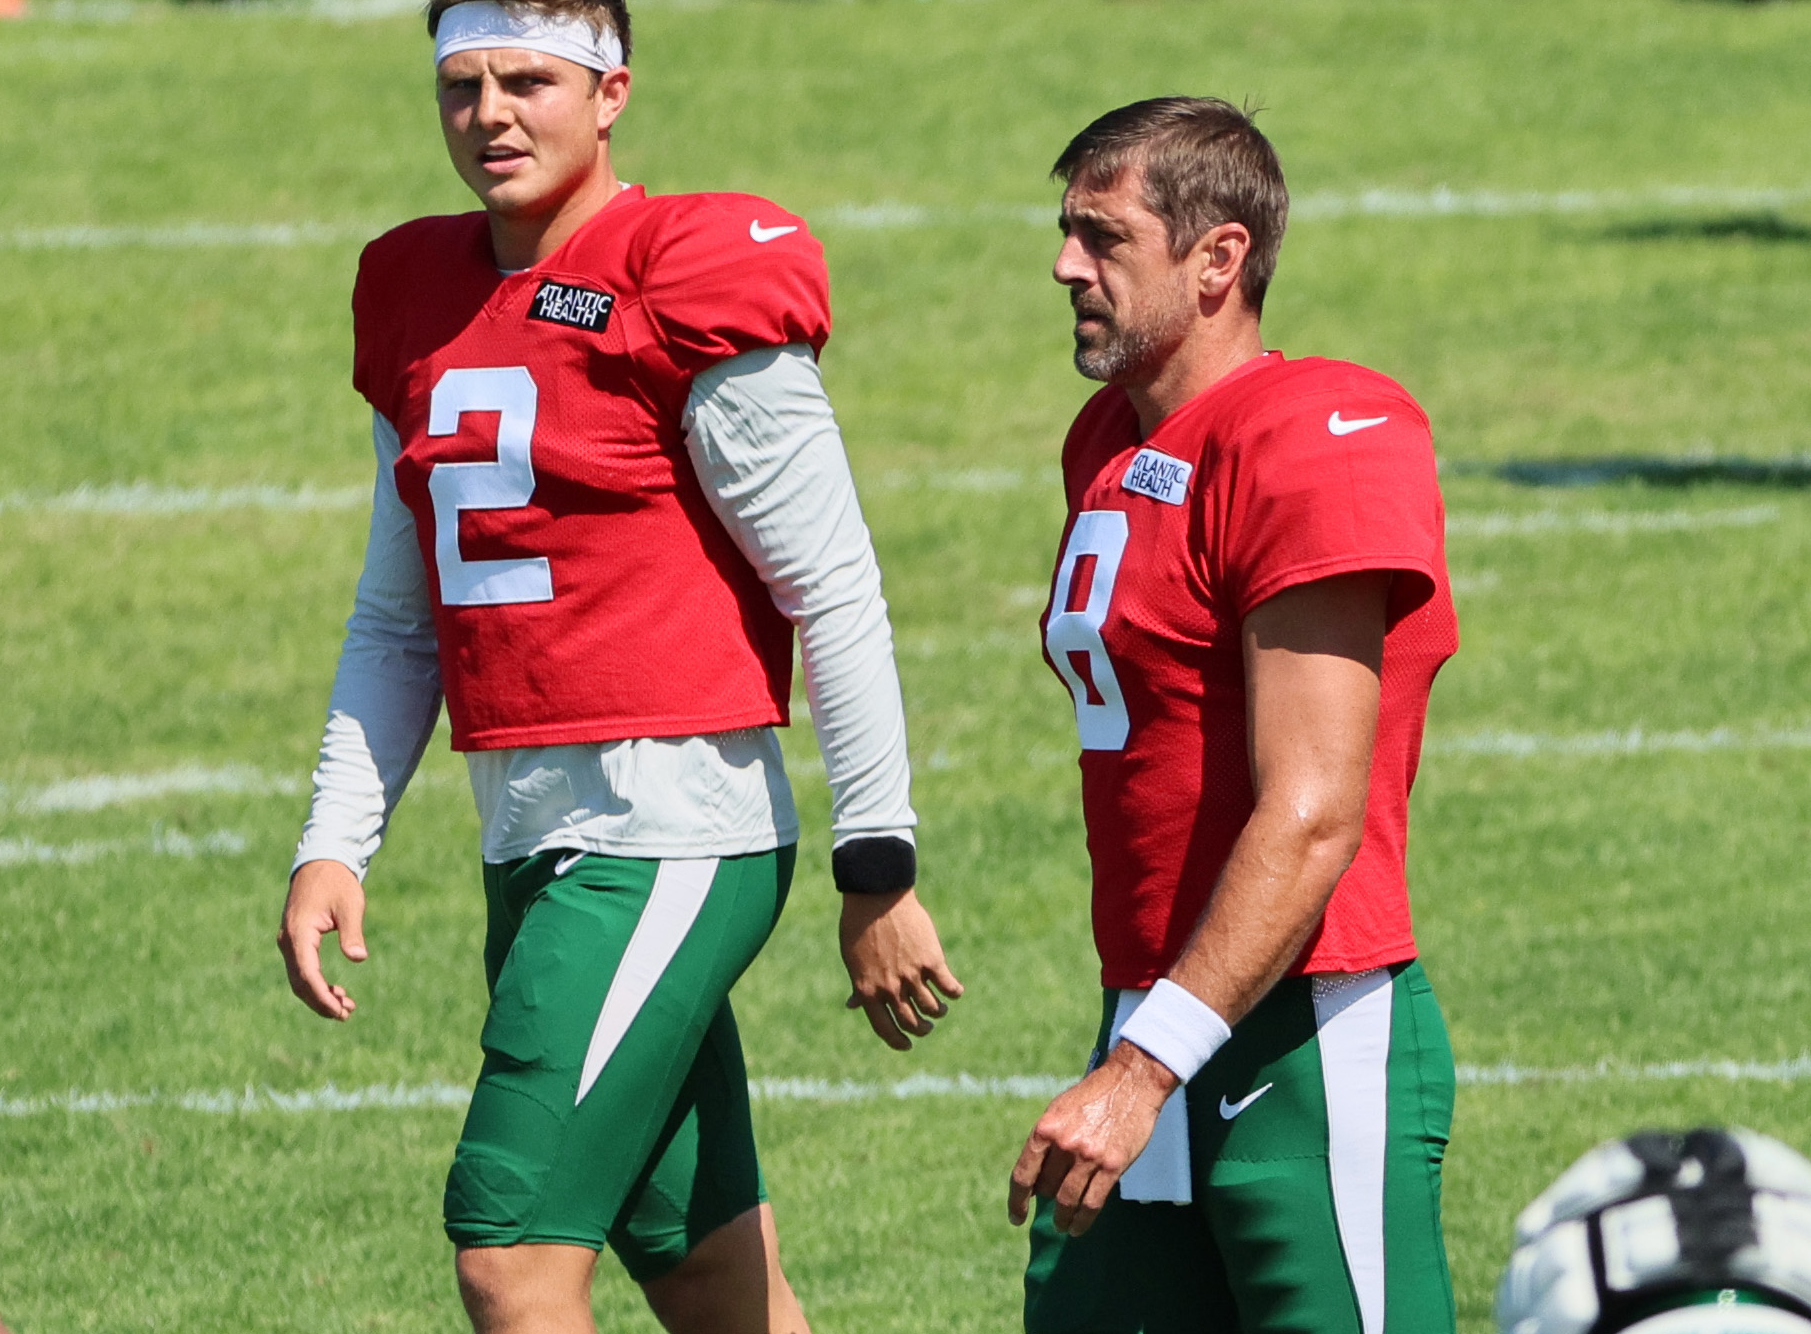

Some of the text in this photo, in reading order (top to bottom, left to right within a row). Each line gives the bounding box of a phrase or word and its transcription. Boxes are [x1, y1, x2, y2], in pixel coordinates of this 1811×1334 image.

[535, 284, 612, 314] ATLANTIC
[539, 300, 598, 327] HEALTH
[1130, 470, 1173, 498] HEALTH
[1134, 455, 1186, 484] ATLANTIC
[426, 365, 554, 605] 2
[1045, 510, 1130, 751] 8
